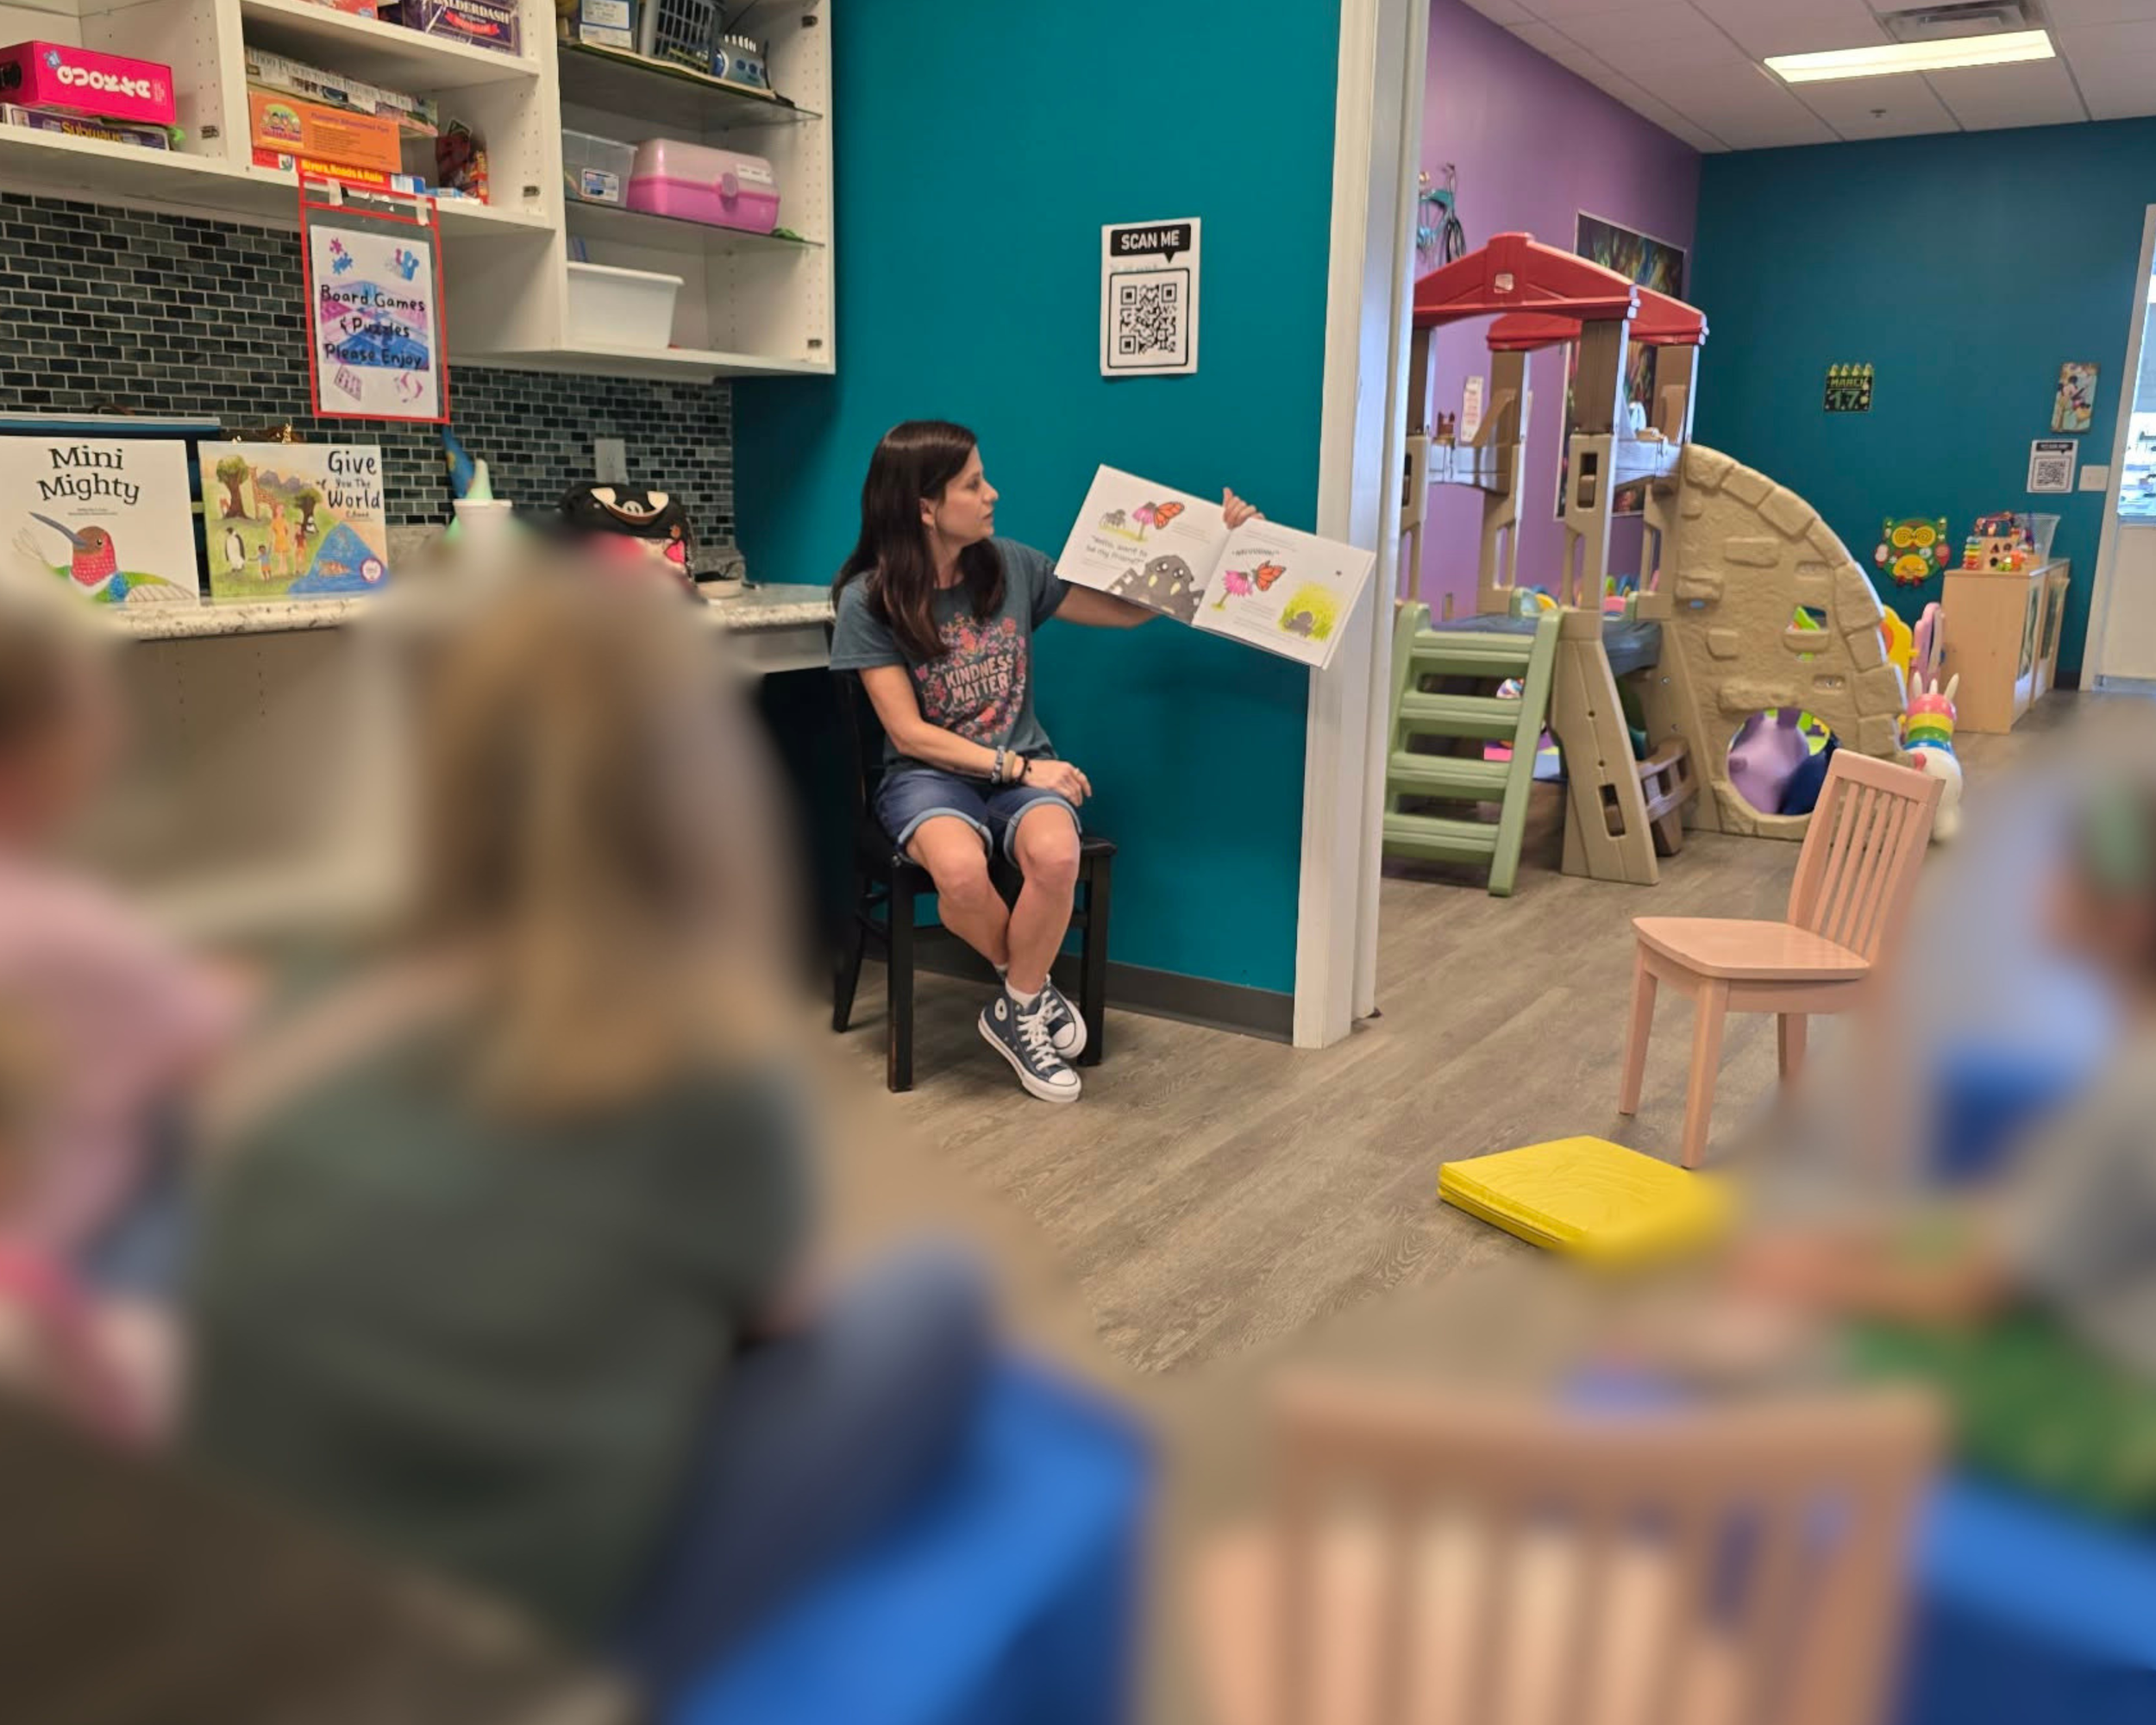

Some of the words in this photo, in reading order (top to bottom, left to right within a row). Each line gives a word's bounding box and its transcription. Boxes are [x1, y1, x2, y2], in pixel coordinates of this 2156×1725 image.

[57, 66, 152, 99] QUOKKA
[1121, 232, 1157, 250] SCAN
[1161, 229, 1180, 248] ME
[321, 284, 368, 305] Board
[374, 292, 425, 311] Games
[323, 343, 375, 361] Please
[381, 348, 423, 370] Enjoy
[1834, 390, 1860, 410] 17
[48, 445, 123, 470] Mini
[328, 450, 377, 475] Give
[36, 473, 140, 506] Mighty
[335, 478, 352, 489] You
[354, 478, 371, 489] The
[328, 489, 380, 509] World
[945, 654, 1013, 688] KINDNESS
[951, 672, 1012, 705] MATTER
